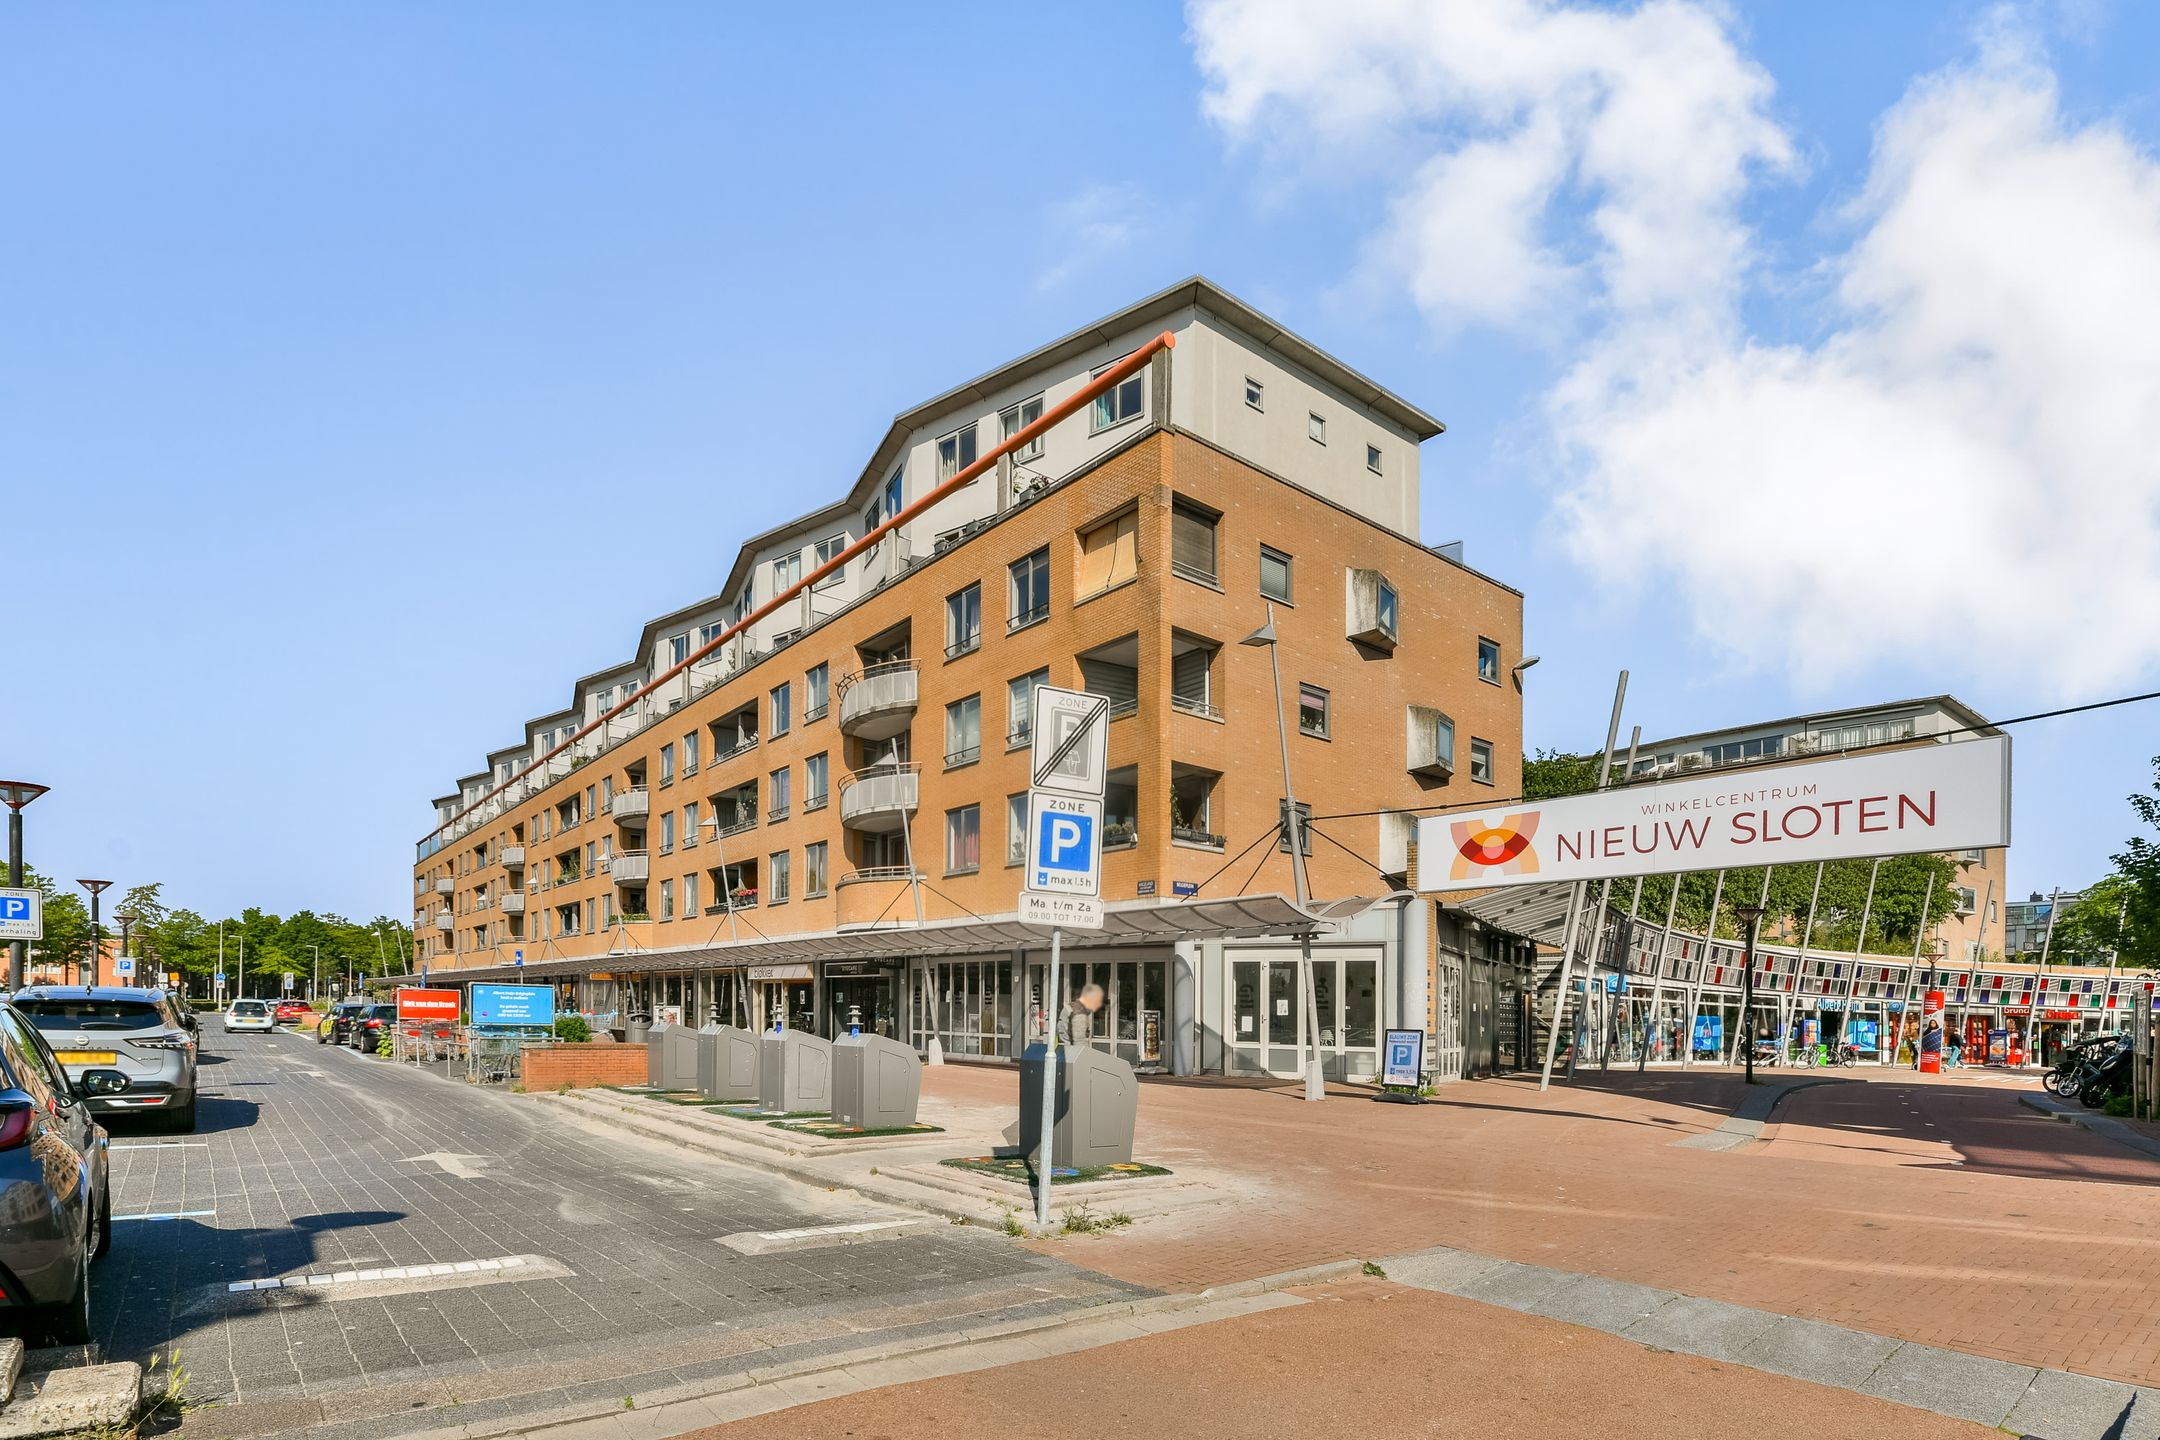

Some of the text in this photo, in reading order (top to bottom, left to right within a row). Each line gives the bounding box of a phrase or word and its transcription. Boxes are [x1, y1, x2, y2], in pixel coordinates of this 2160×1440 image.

[1058, 696, 1088, 710] ZONE
[1049, 799, 1085, 813] ZONE
[1641, 783, 1817, 816] WINKELCENTRUM
[1557, 790, 1936, 862] NIEUW SLOTEN
[1051, 818, 1081, 863] P
[1050, 875, 1073, 886] max
[7, 899, 24, 918] P
[1053, 900, 1073, 911] t/m
[1053, 913, 1070, 921] TOT
[1817, 997, 1860, 1012] Albert Hijn
[1396, 1046, 1408, 1064] P
